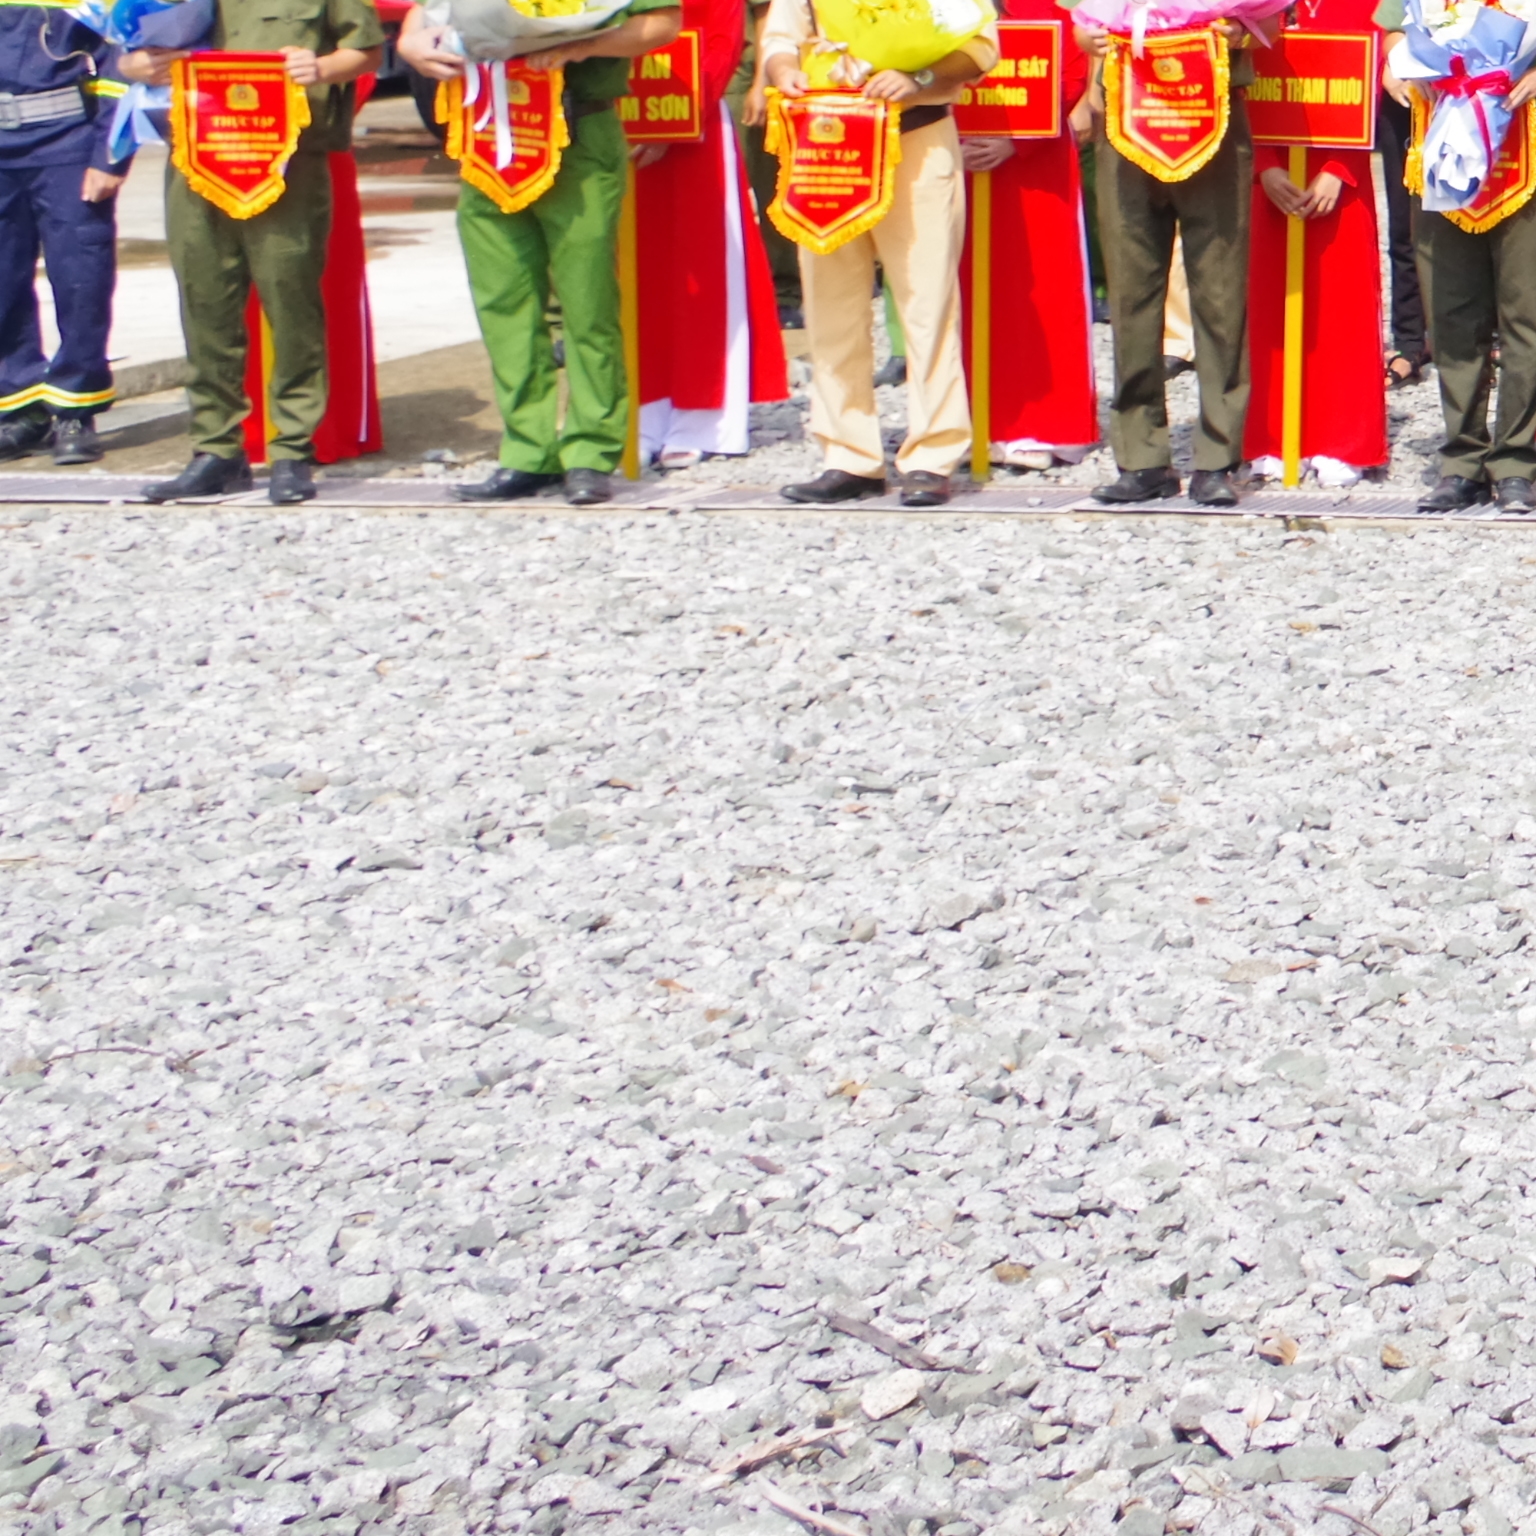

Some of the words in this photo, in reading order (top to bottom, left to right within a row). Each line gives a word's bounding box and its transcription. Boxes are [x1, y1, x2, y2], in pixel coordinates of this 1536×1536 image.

[640, 52, 672, 79] AN
[1017, 54, 1050, 78] SÁT
[976, 83, 1028, 107] THÔNG
[1285, 77, 1327, 104] THAM
[1328, 76, 1363, 105] MƯU
[645, 93, 690, 122] SƠN
